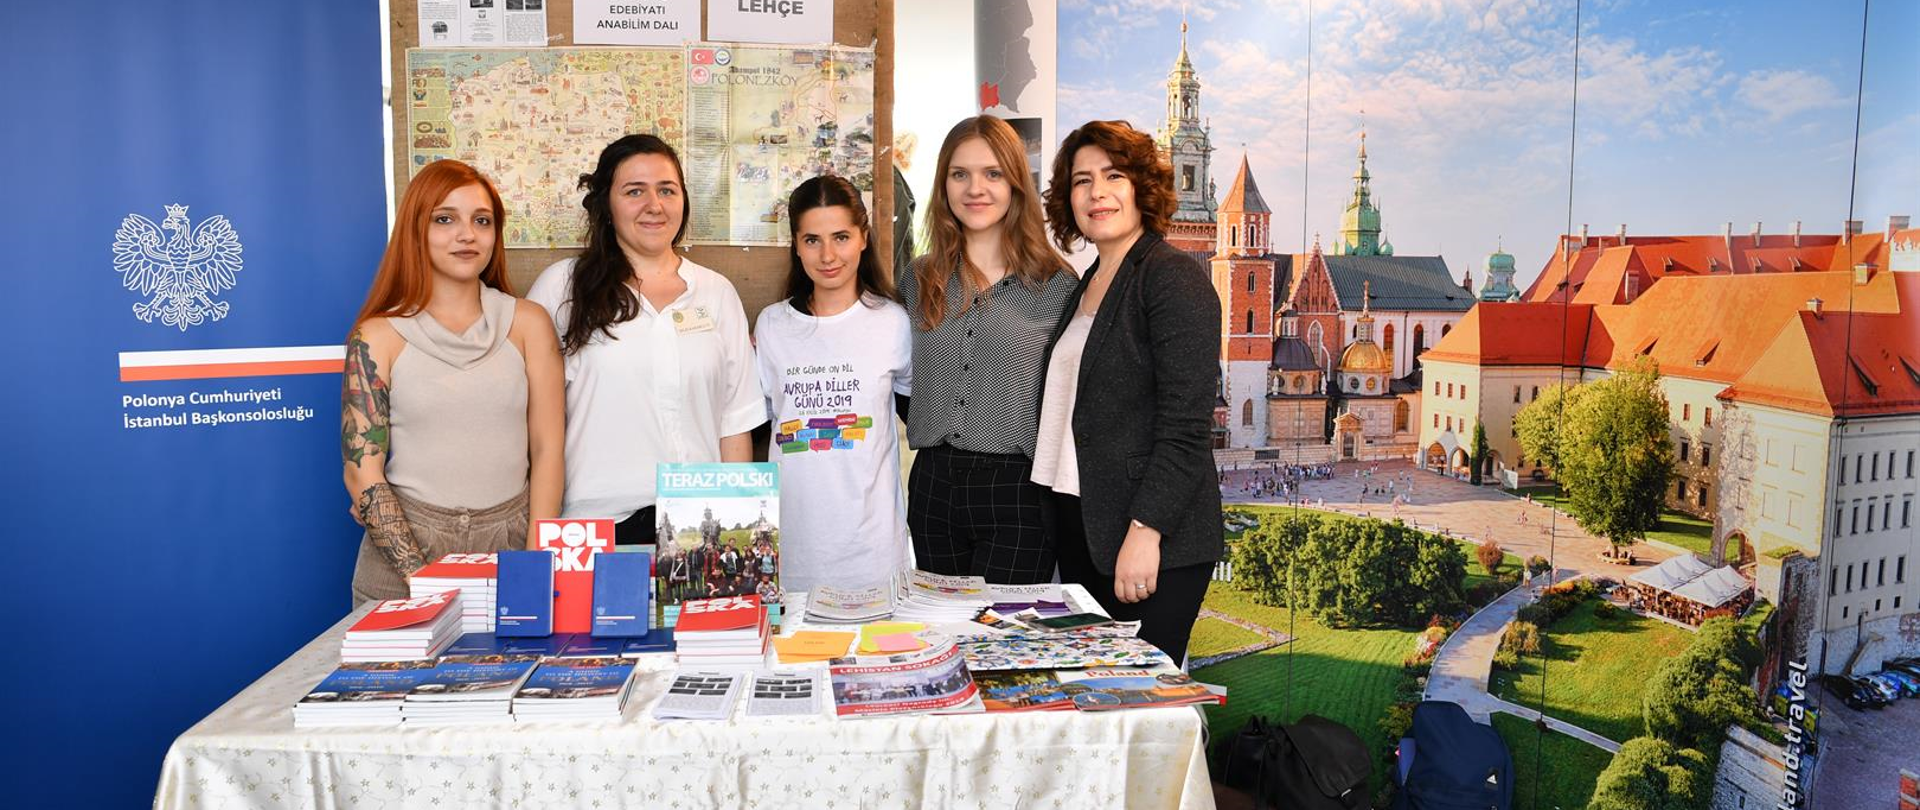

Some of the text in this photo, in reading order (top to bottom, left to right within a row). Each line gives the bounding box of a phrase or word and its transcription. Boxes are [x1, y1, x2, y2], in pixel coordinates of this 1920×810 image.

[609, 3, 666, 15] EDEBİYATI
[738, 0, 804, 18] LEHÇE
[597, 18, 679, 31] ANABİLİM DALI
[829, 365, 839, 374] ON
[784, 377, 860, 396] AVRUPA DİLLER
[122, 388, 282, 409] Polonya Cumhuriyeti
[794, 393, 852, 409] GÜNÜ 2019
[124, 407, 314, 429] İstanbul Başkonsolosluğu
[661, 472, 774, 488] TERAZ POLSKI
[539, 522, 608, 547] POL
[1085, 669, 1149, 678] Poland
